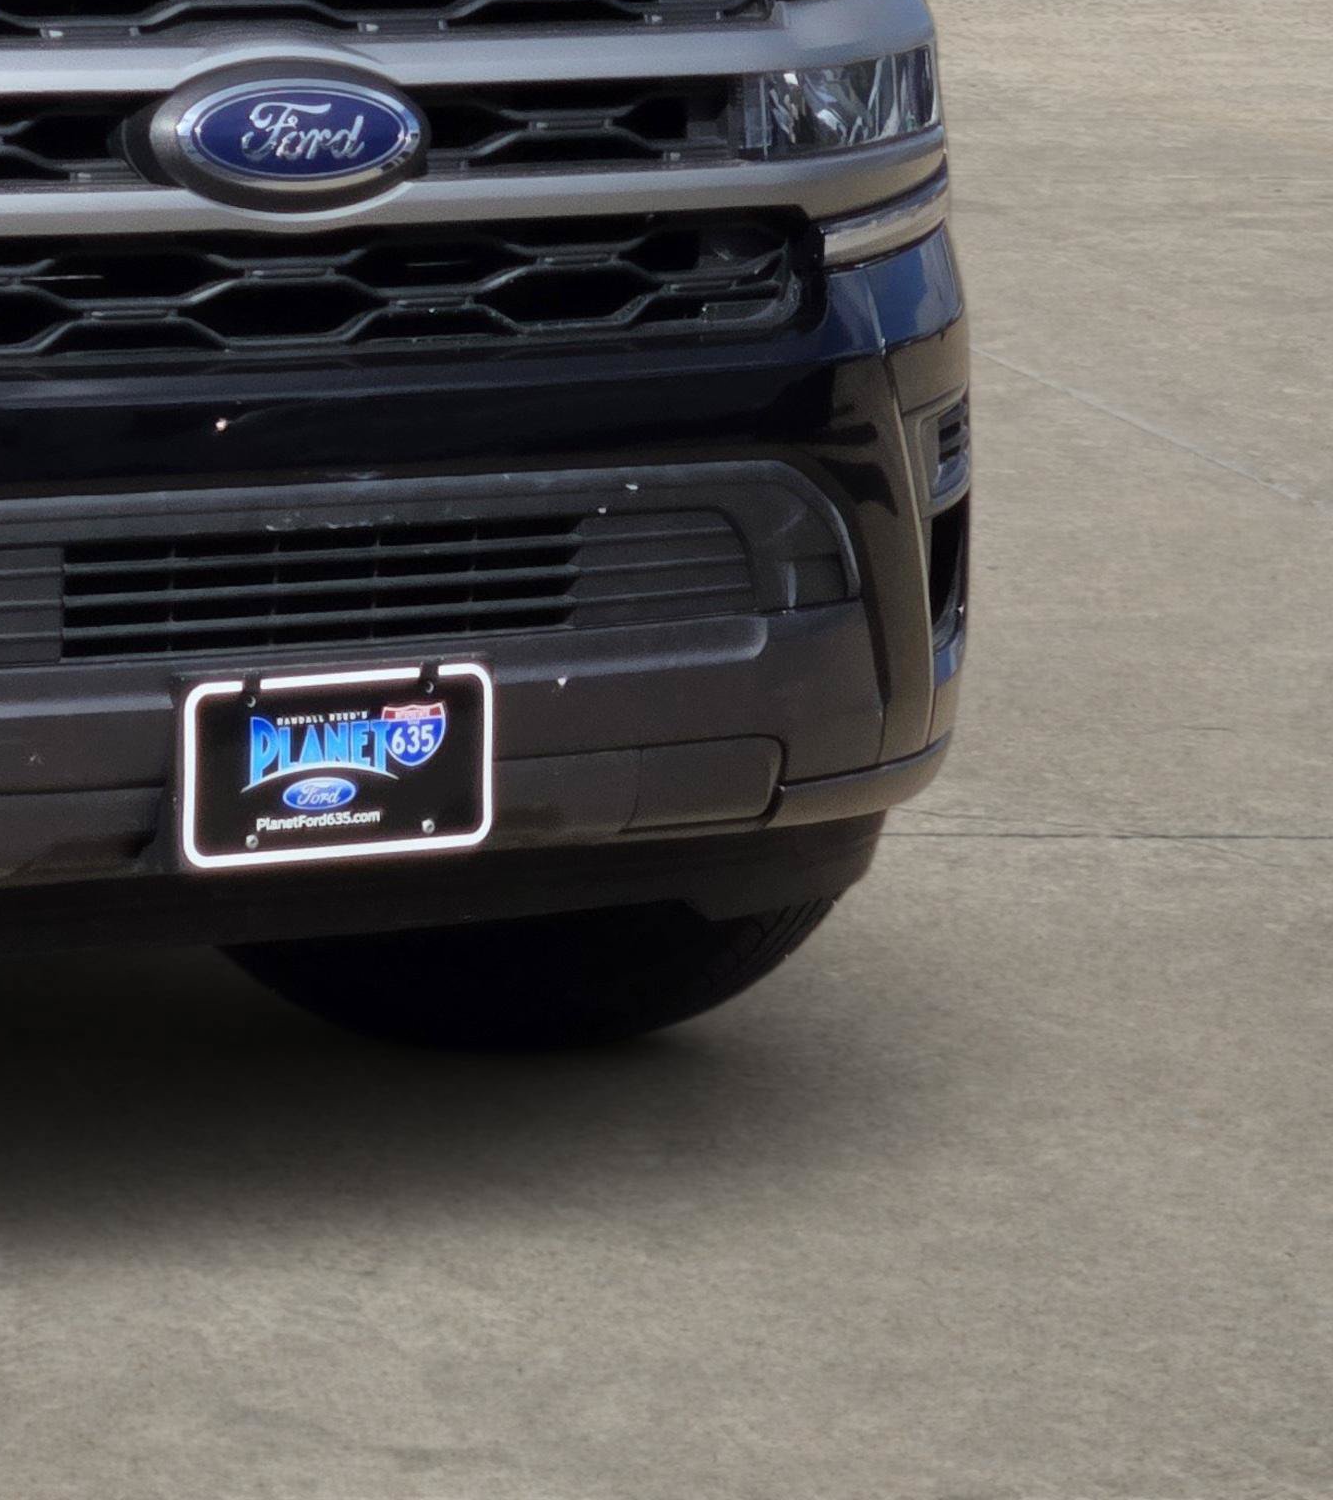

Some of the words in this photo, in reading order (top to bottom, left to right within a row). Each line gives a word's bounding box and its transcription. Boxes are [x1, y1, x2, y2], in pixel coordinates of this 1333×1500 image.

[241, 102, 365, 160] Ford
[250, 716, 391, 787] PLANET
[391, 723, 435, 755] 635
[297, 780, 341, 805] Ford
[256, 810, 381, 832] PlanetFord635.com
